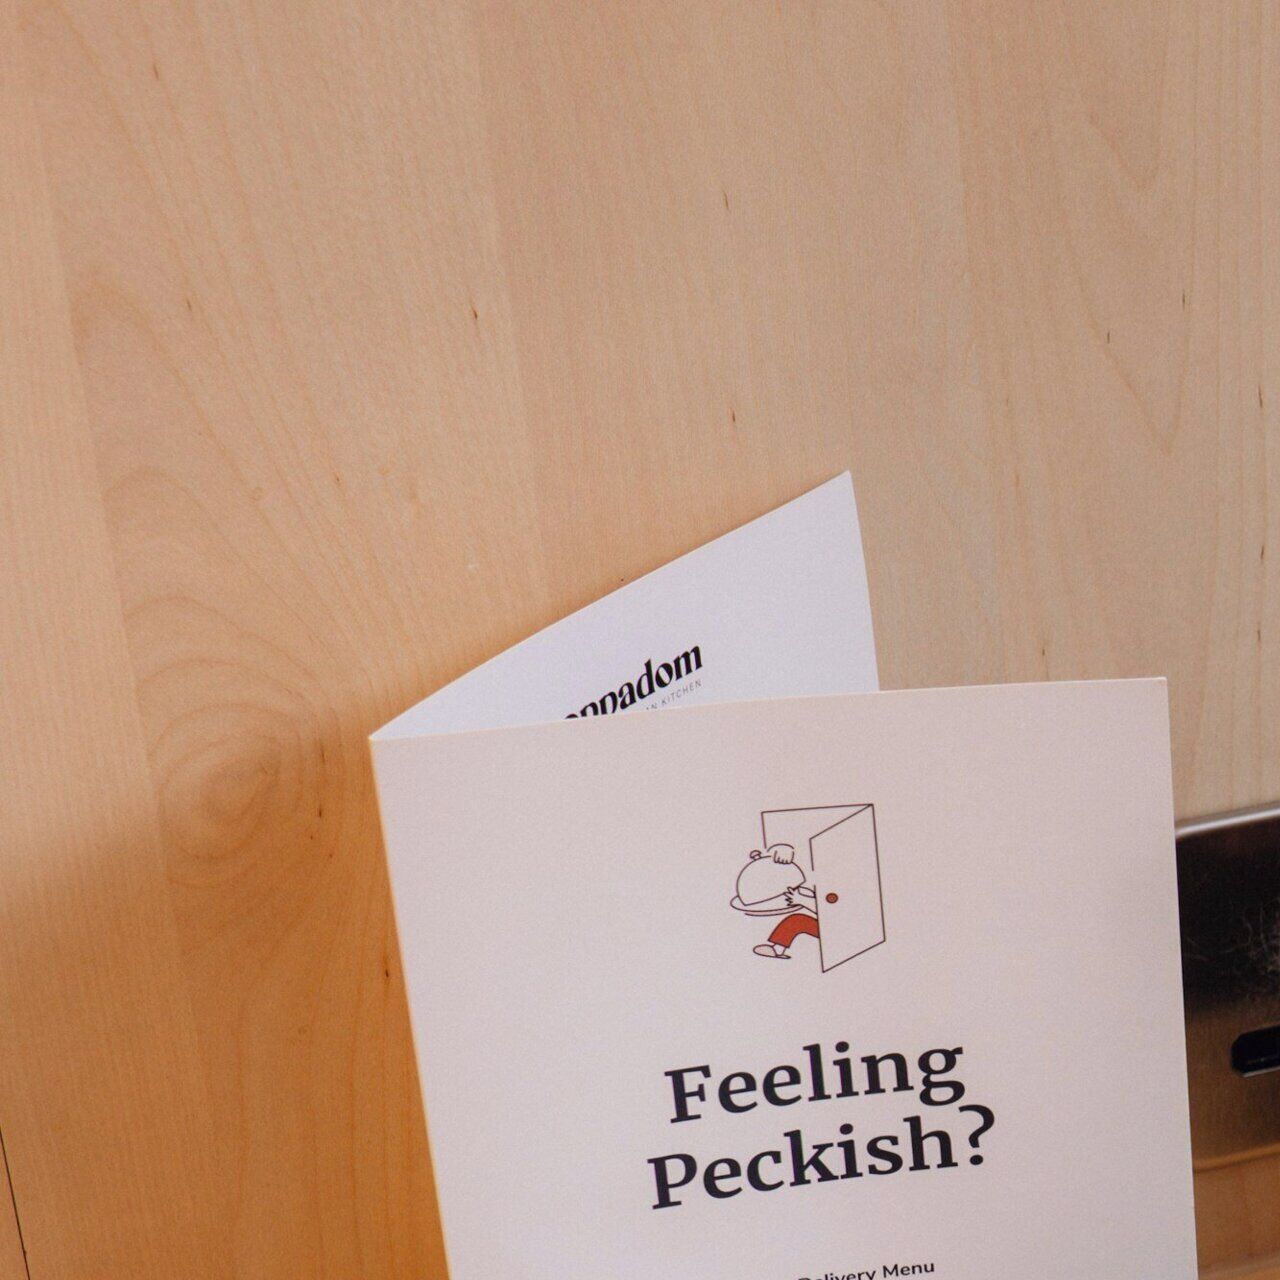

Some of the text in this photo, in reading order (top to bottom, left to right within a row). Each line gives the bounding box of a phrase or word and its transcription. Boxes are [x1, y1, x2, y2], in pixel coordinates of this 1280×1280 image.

[661, 680, 702, 706] KITCHEN
[664, 1040, 966, 1124] Feeling
[646, 1103, 995, 1210] Peckish?
[882, 1262, 935, 1279] Menu
